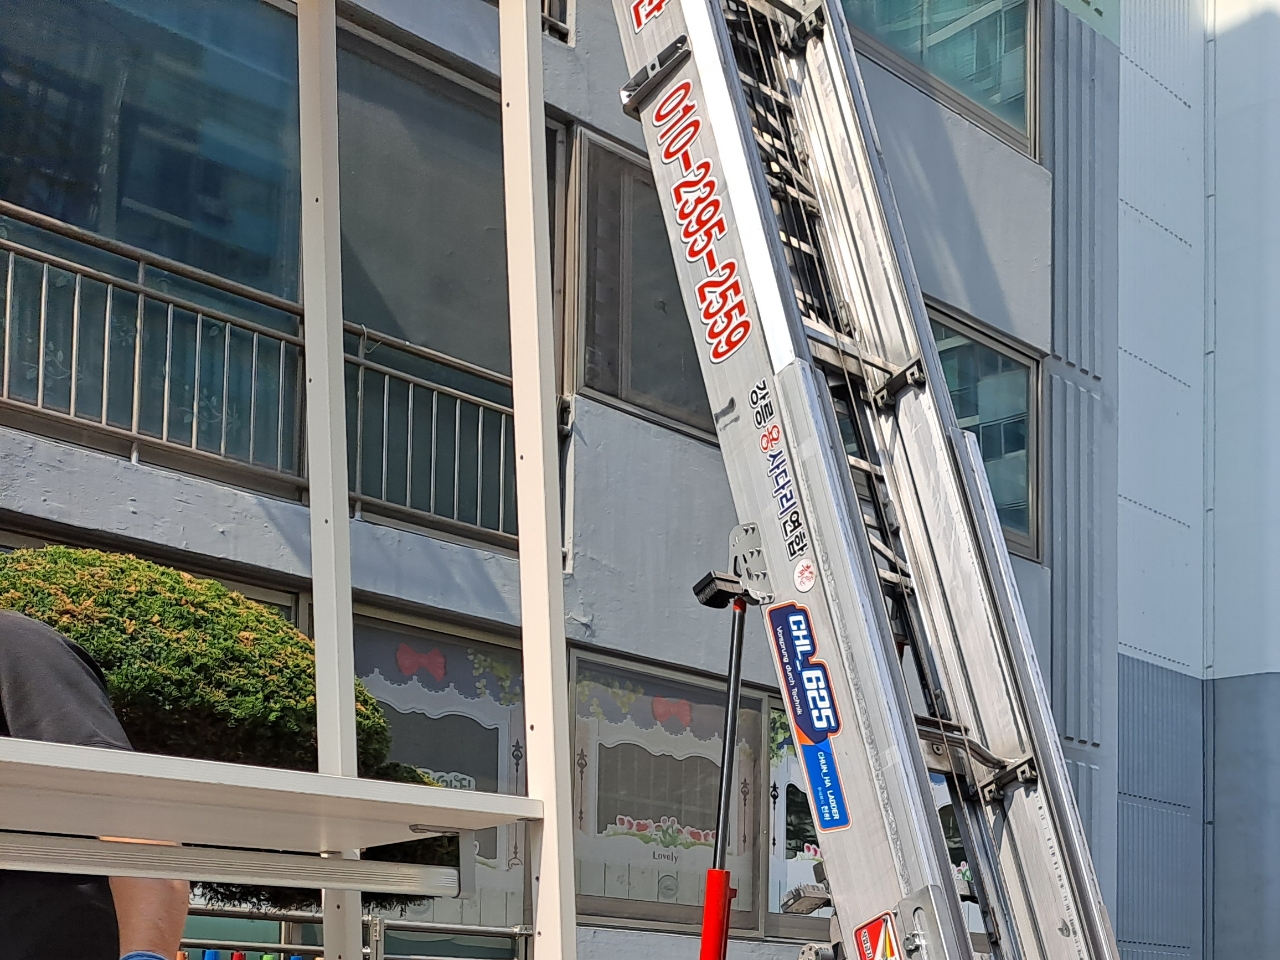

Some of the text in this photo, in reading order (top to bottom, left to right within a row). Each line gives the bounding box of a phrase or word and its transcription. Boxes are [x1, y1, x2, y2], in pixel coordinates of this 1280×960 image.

[654, 81, 752, 362] 010-2395-2559
[776, 626, 802, 716] Vorsprung durch Technik
[827, 789, 840, 820] LADDER
[652, 851, 678, 864] Lovely
